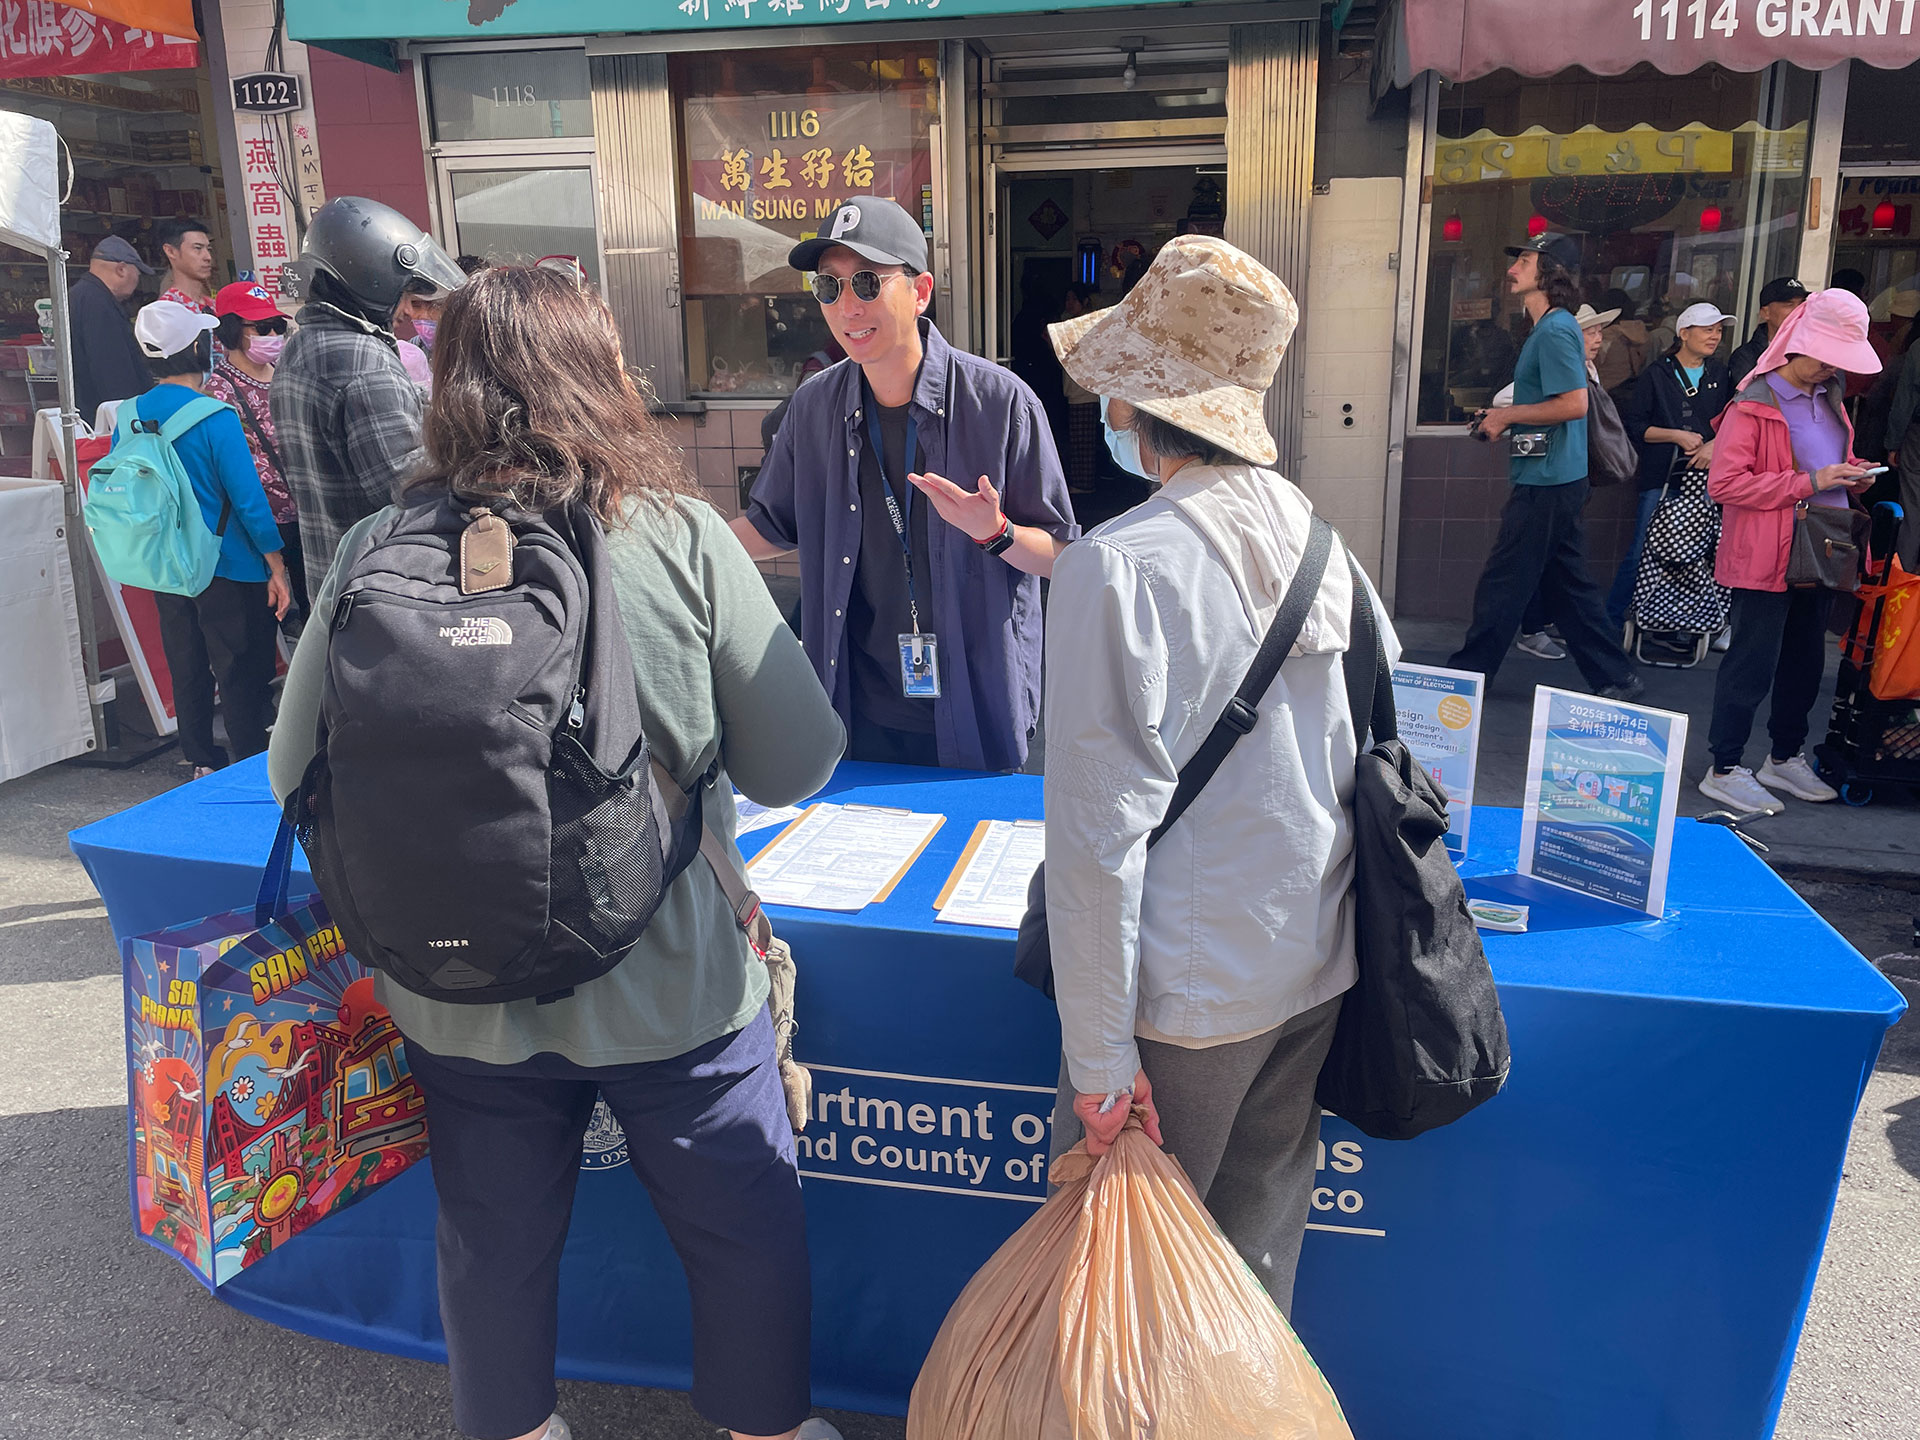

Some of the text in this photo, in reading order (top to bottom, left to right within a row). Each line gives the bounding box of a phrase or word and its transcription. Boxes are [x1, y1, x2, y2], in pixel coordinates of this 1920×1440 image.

[1632, 0, 1920, 40] 1114 GRANT
[241, 81, 290, 105] 1122
[491, 84, 536, 108] 1118
[770, 109, 820, 138] 1116
[700, 199, 745, 221] MAN
[752, 198, 807, 220] SUNG
[885, 496, 904, 534] ELECTIONS
[439, 627, 488, 637] NORTH
[461, 617, 489, 627] THE
[451, 636, 488, 646] FACE
[1423, 681, 1455, 690] ELECTIONS
[1414, 722, 1440, 732] design
[1569, 704, 1649, 731] 2025年11月4日
[428, 939, 469, 948] YODER
[249, 944, 310, 1006] SAN
[167, 979, 197, 1006] SA
[807, 1087, 994, 1140] rtment
[851, 1134, 991, 1185] County
[1004, 1153, 1045, 1183] of
